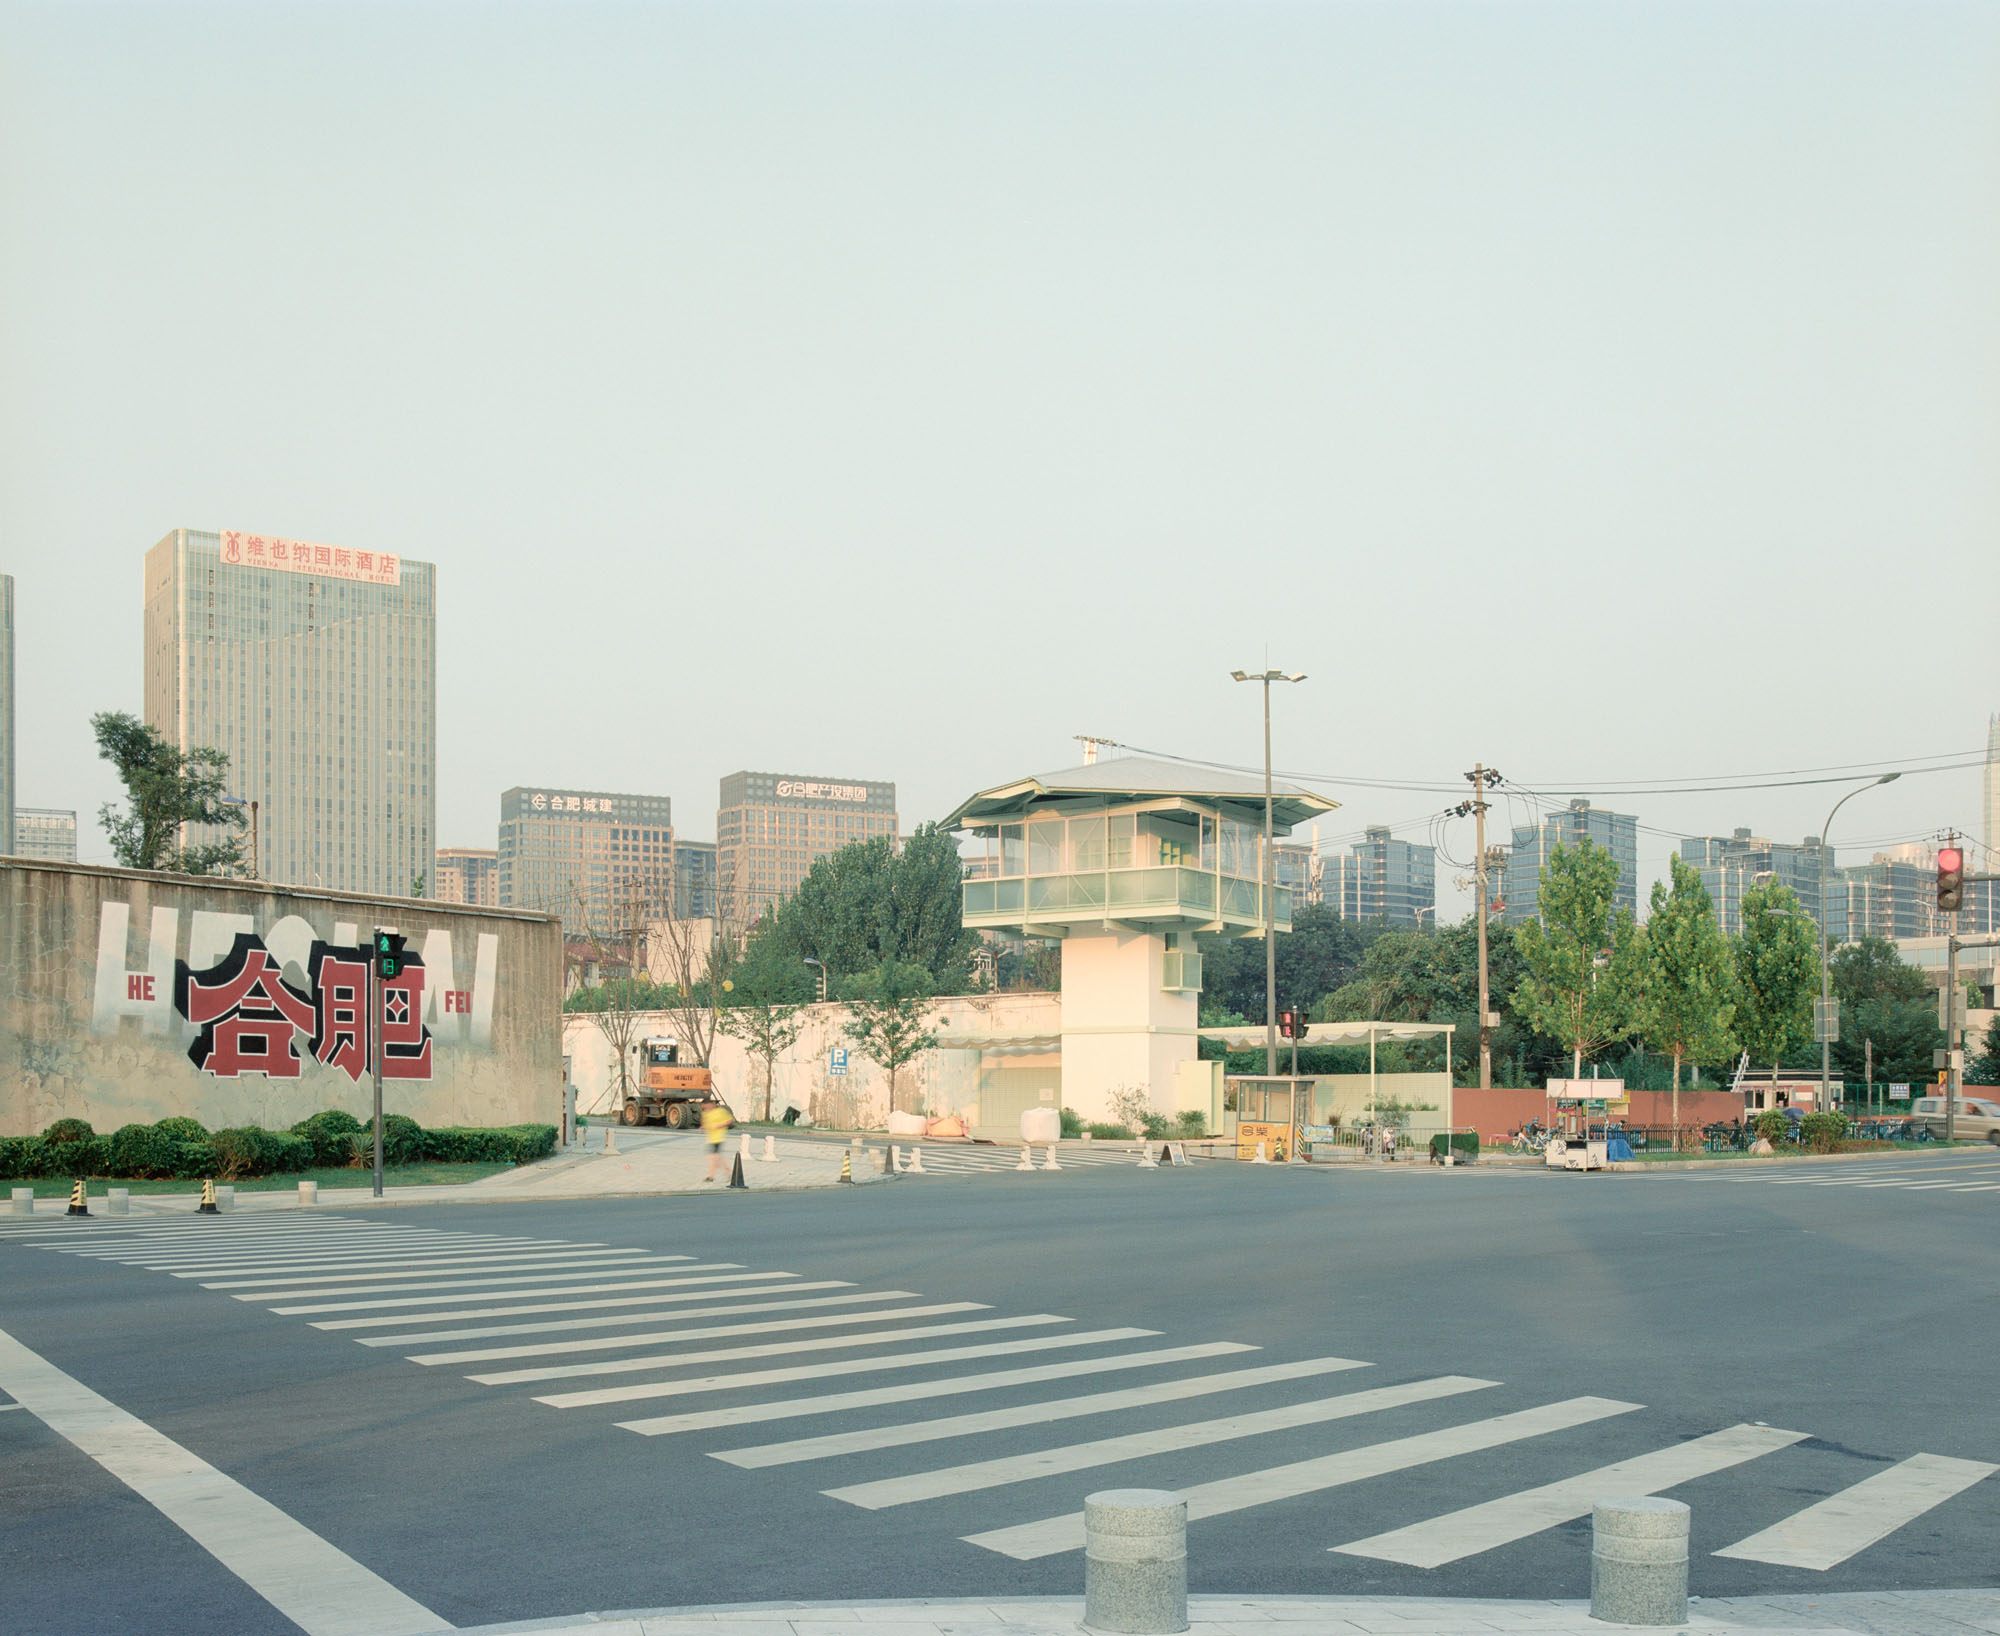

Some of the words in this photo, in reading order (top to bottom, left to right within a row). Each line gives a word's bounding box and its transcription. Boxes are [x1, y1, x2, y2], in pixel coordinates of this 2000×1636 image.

[247, 536, 396, 575] 维也纳国际酒店
[550, 796, 613, 813] 合肥城建
[127, 974, 156, 1001] HE
[180, 940, 434, 1084] 合肥
[444, 990, 472, 1013] FEI
[833, 1049, 845, 1063] P
